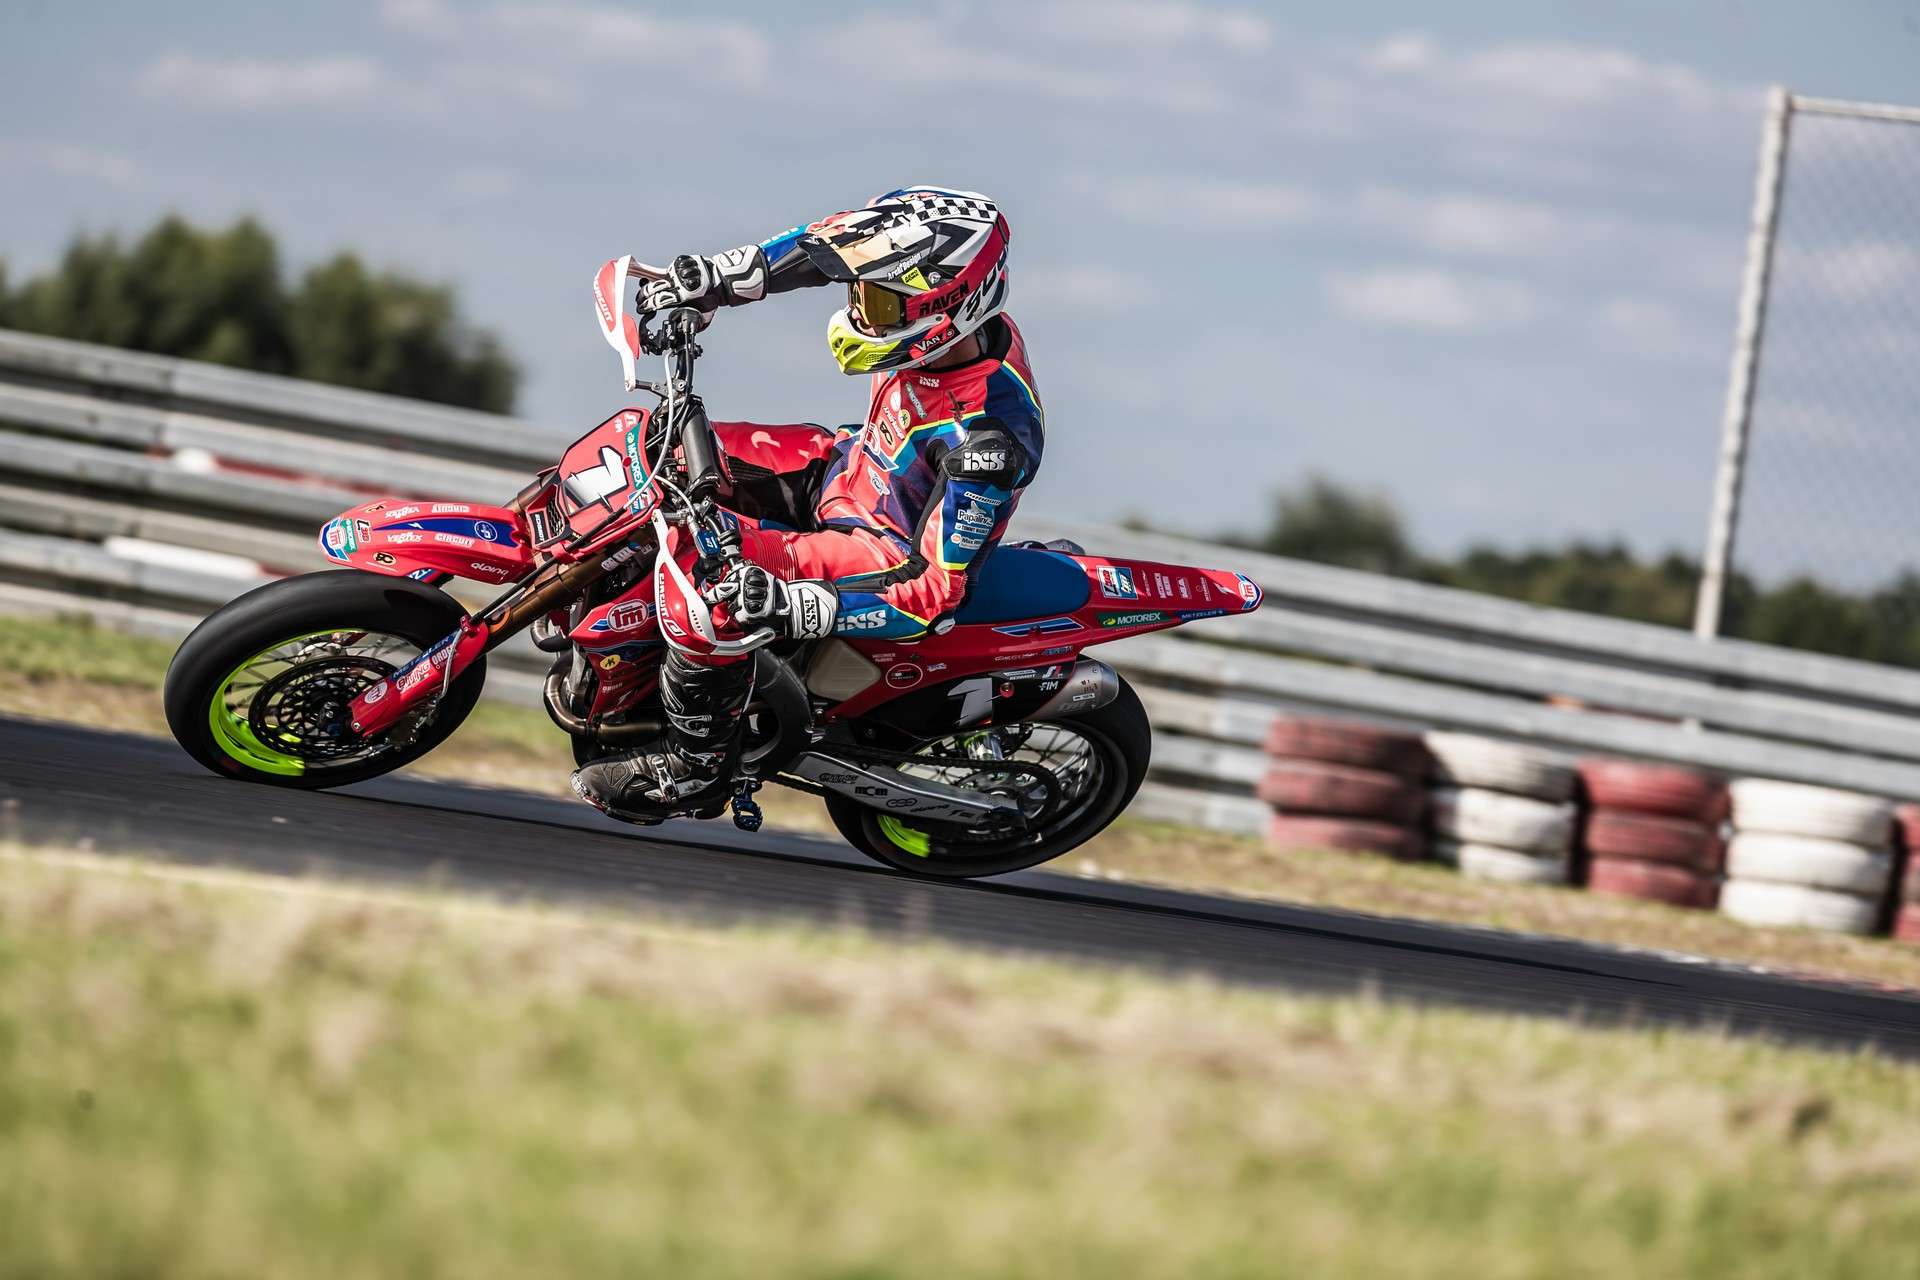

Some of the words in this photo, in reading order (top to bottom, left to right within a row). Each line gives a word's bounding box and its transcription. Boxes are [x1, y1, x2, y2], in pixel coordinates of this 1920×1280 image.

[919, 280, 970, 317] RAVEN
[626, 443, 645, 488] MOTOREX
[435, 533, 475, 548] CIRCUIT
[470, 562, 510, 577] alpina
[659, 572, 669, 618] CIRCUIT
[1117, 613, 1161, 625] MOTOREX
[1040, 681, 1059, 692] FIM
[947, 678, 992, 727] 1
